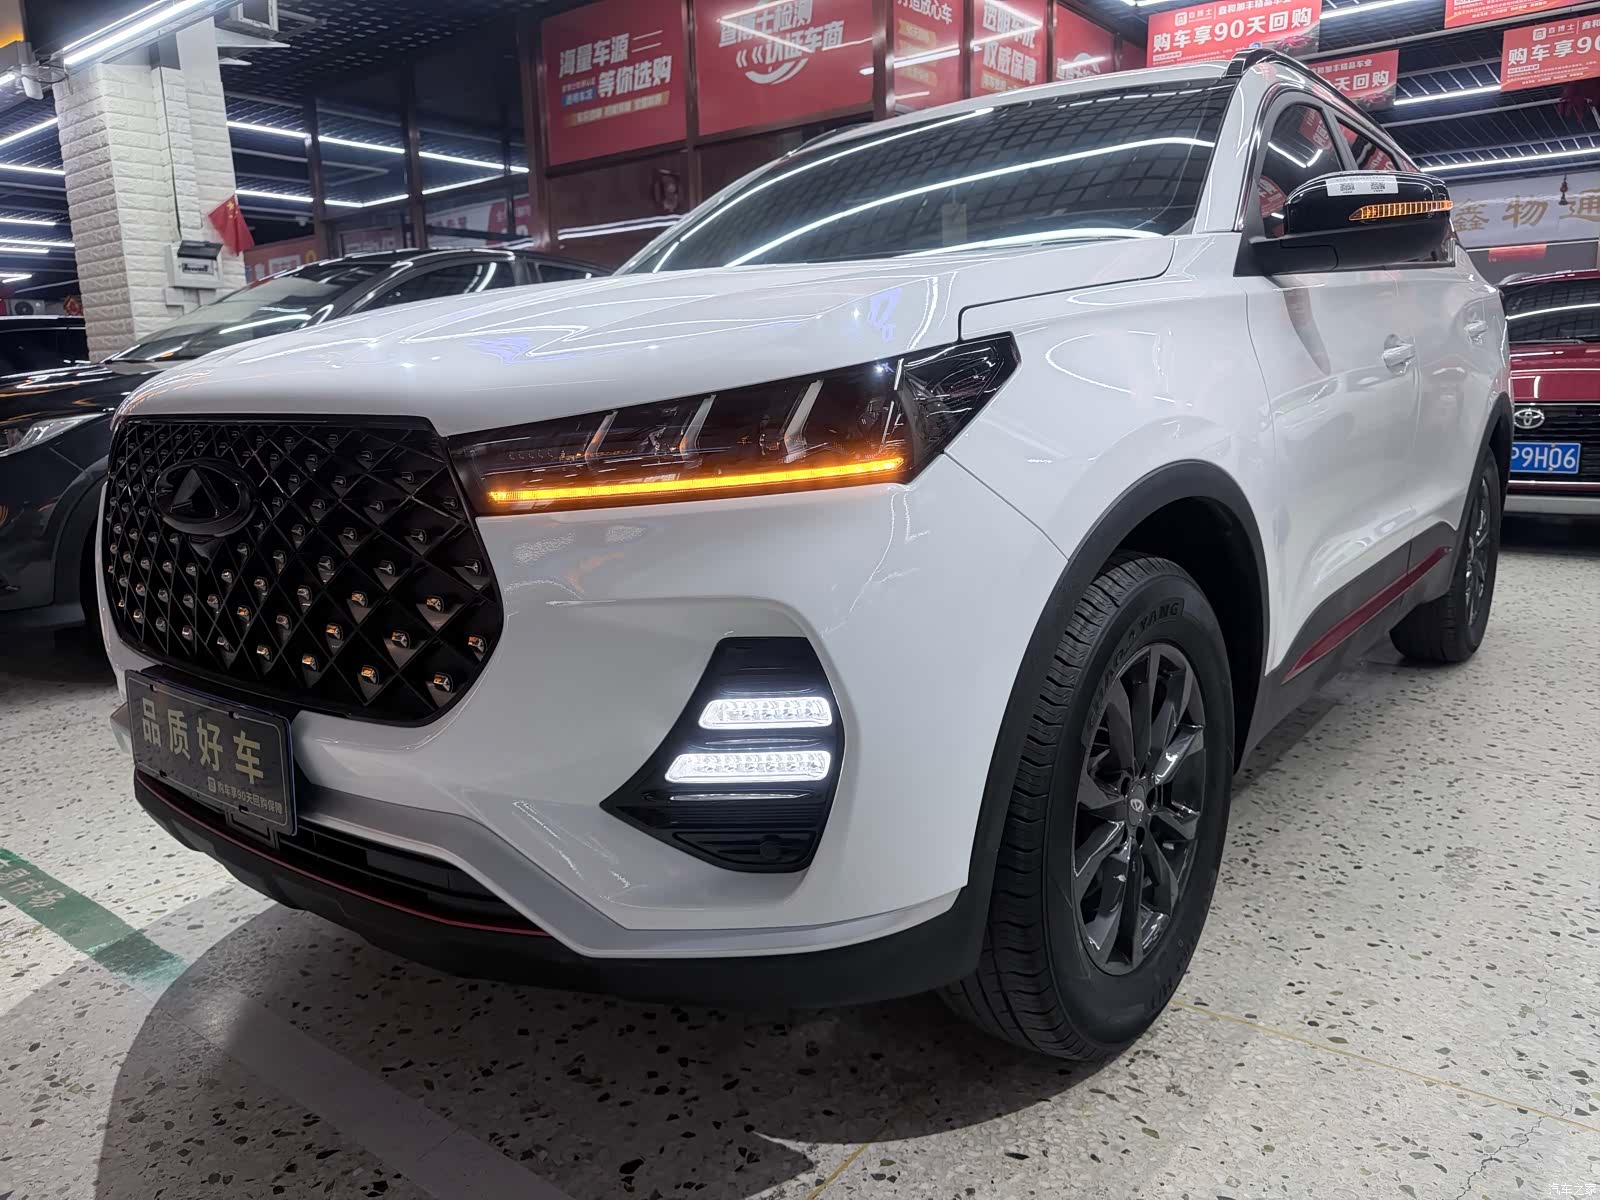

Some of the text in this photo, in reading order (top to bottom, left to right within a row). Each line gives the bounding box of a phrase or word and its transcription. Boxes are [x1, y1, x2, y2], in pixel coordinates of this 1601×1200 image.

[1153, 7, 1312, 53] 购车享90天回购
[559, 33, 629, 79] 海量车源
[598, 55, 672, 98] 等你选购
[142, 698, 264, 785] 品质好车
